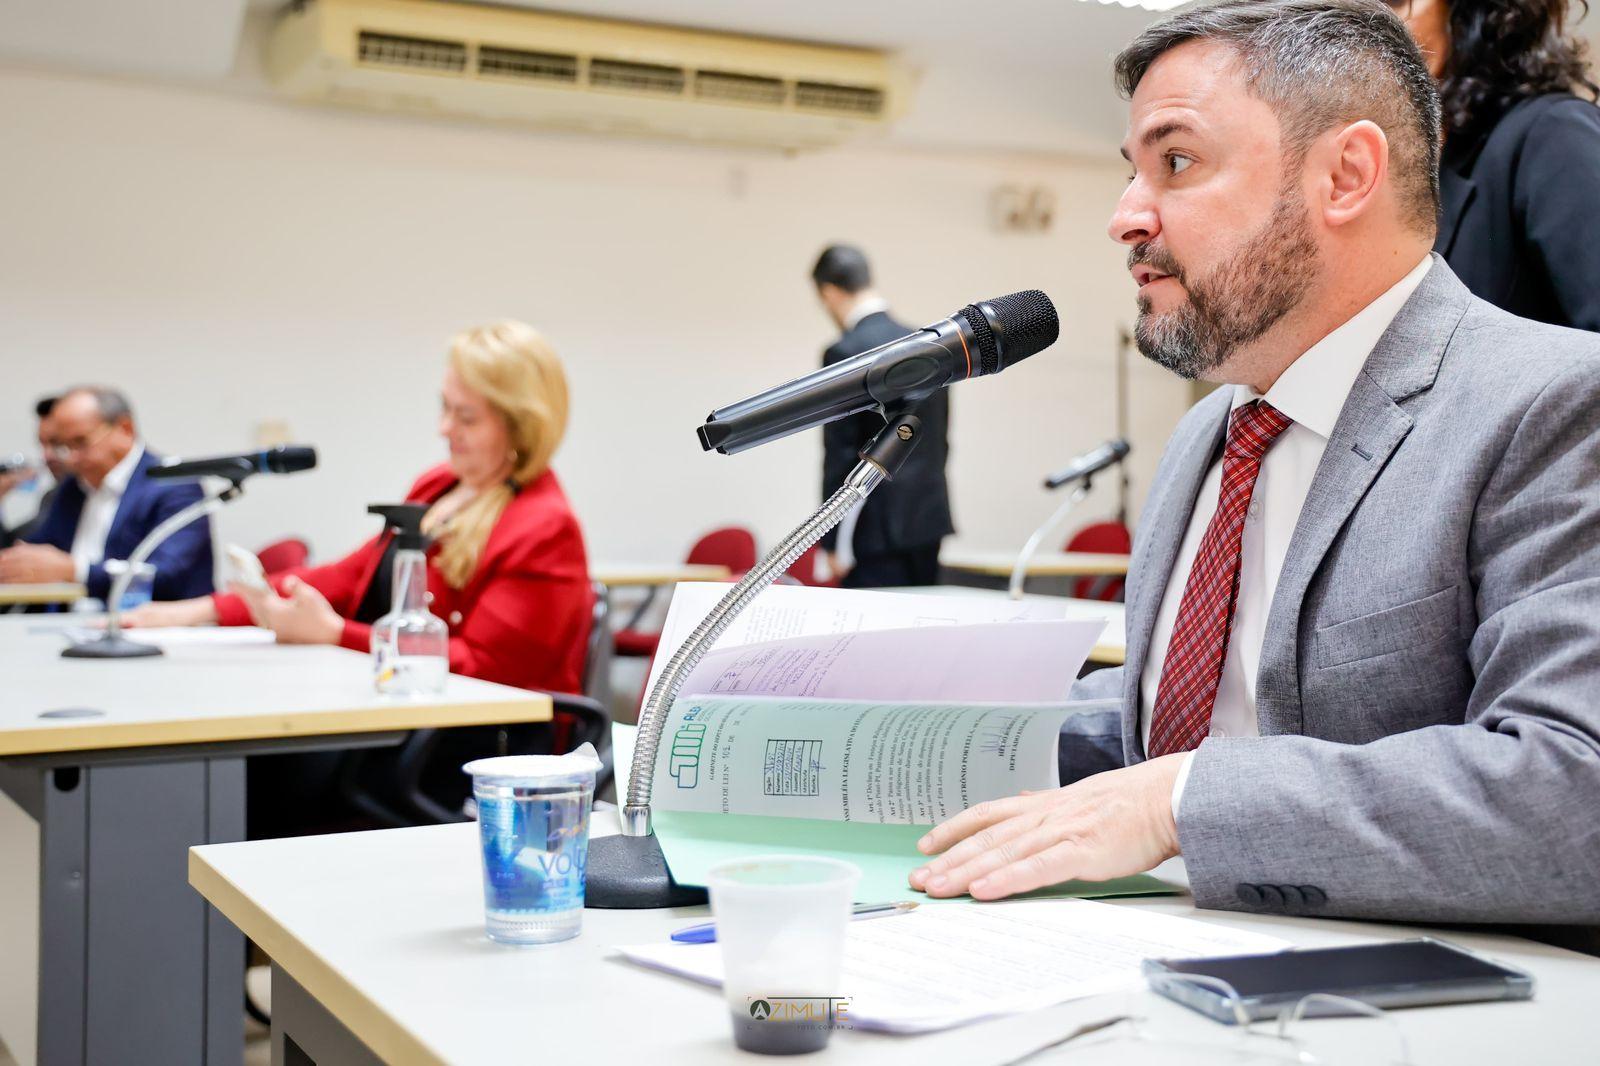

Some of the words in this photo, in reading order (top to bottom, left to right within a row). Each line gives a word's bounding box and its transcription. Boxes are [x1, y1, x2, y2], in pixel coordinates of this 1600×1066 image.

[709, 752, 717, 780] GABINETE
[842, 733, 856, 777] LEGISLATIVA
[1009, 735, 1020, 771] DEPUTADO
[959, 764, 968, 801] PETRÔNIO
